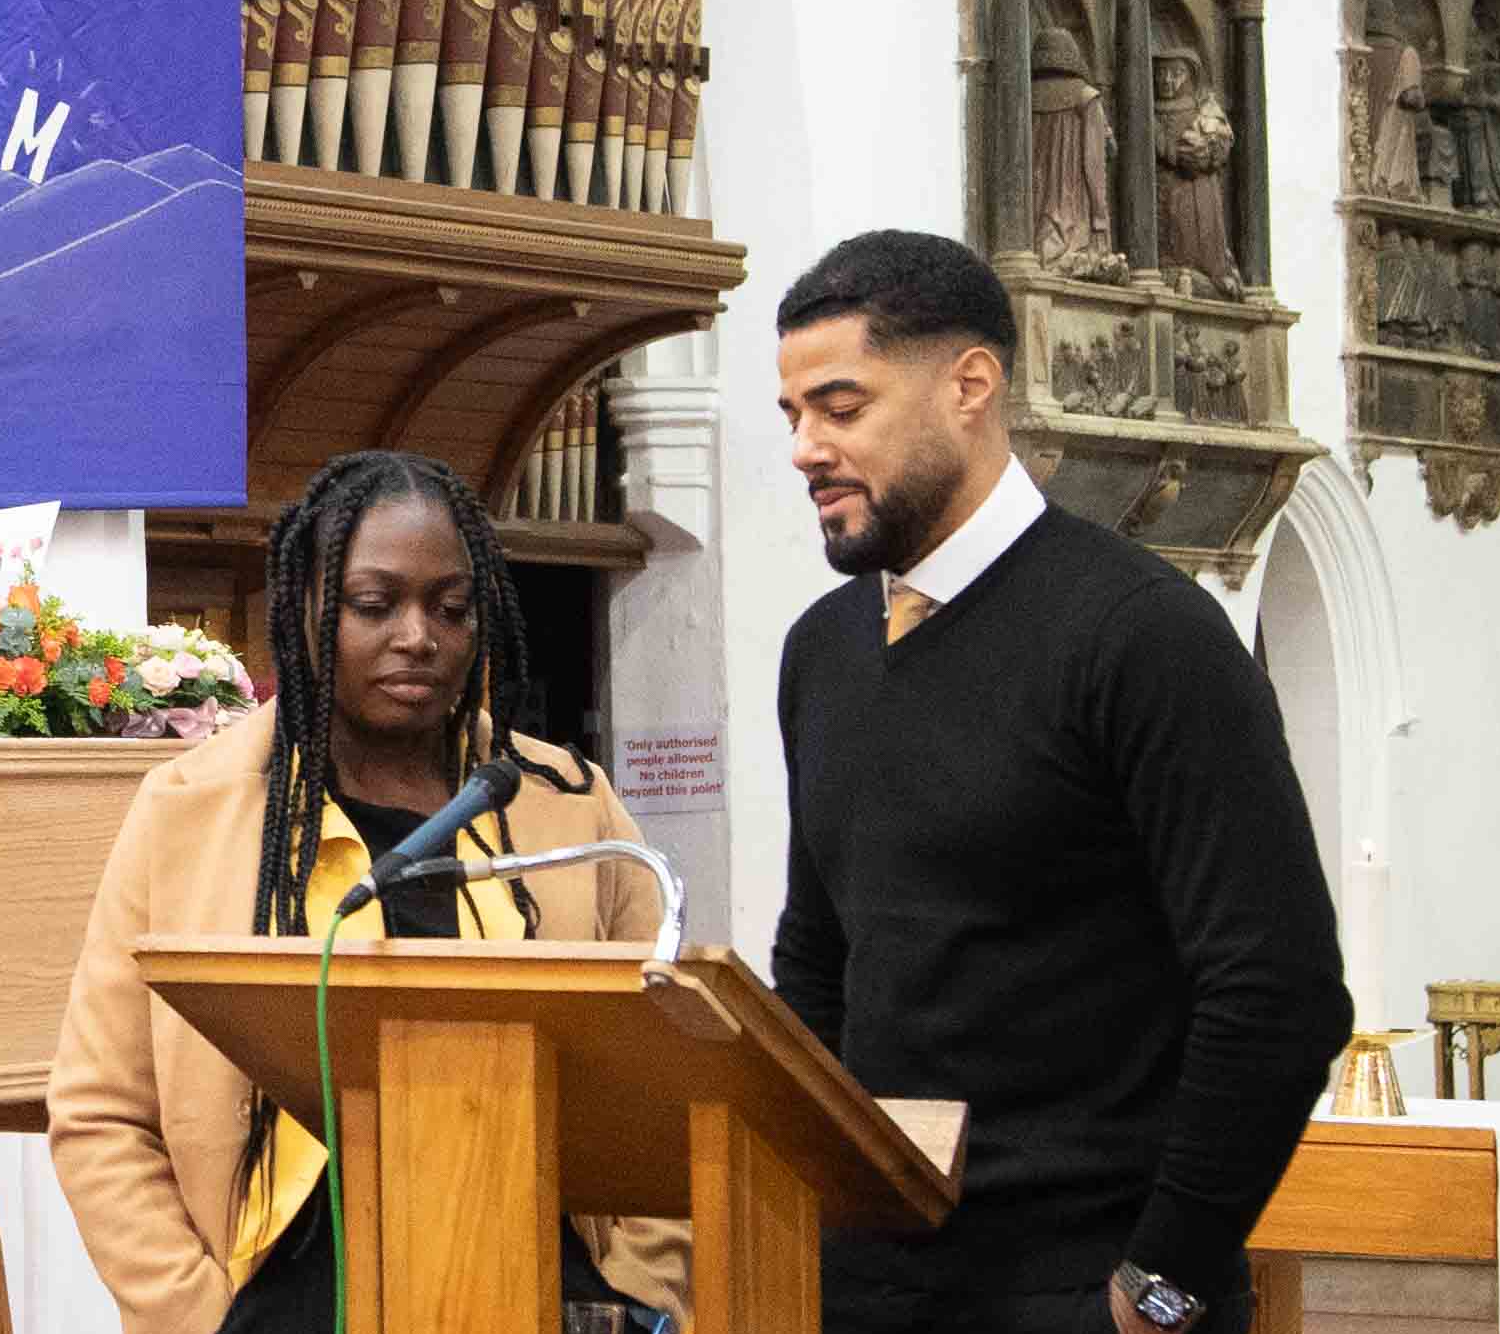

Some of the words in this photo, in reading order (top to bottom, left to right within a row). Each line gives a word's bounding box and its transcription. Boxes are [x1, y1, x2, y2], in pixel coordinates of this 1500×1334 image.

[655, 736, 718, 750] authorised
[626, 754, 664, 769] people
[639, 772, 655, 782] No
[657, 769, 705, 781] children
[621, 786, 663, 799] beyond
[665, 784, 688, 796] this
